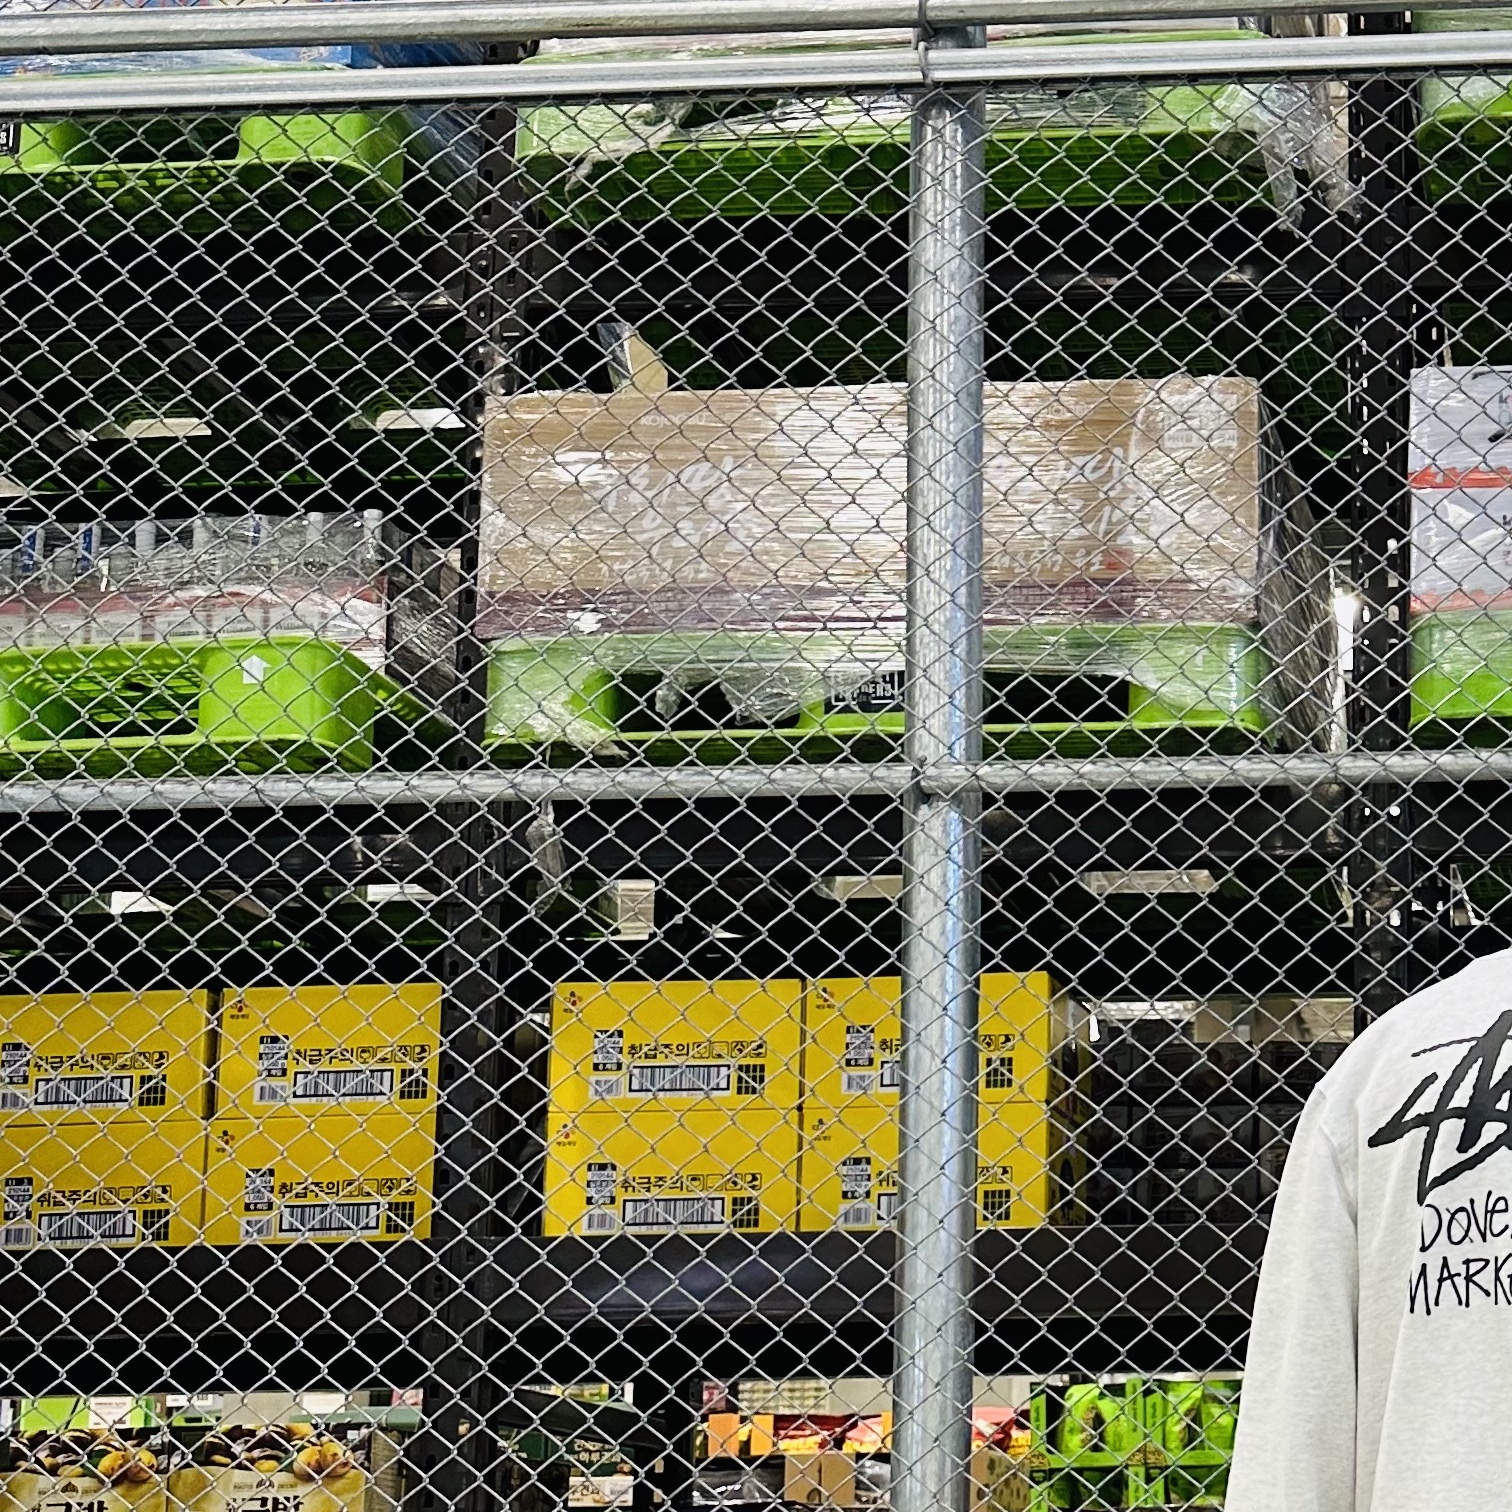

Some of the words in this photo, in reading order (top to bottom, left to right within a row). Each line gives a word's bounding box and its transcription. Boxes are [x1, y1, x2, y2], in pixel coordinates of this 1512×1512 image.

[292, 1047, 354, 1067] 취급주의
[627, 1041, 690, 1059] 취급주의
[34, 1053, 96, 1071] 취급주의
[278, 1179, 341, 1199] 취급주의
[620, 1174, 684, 1193] 취급주의
[38, 1187, 97, 1207] 취급주의
